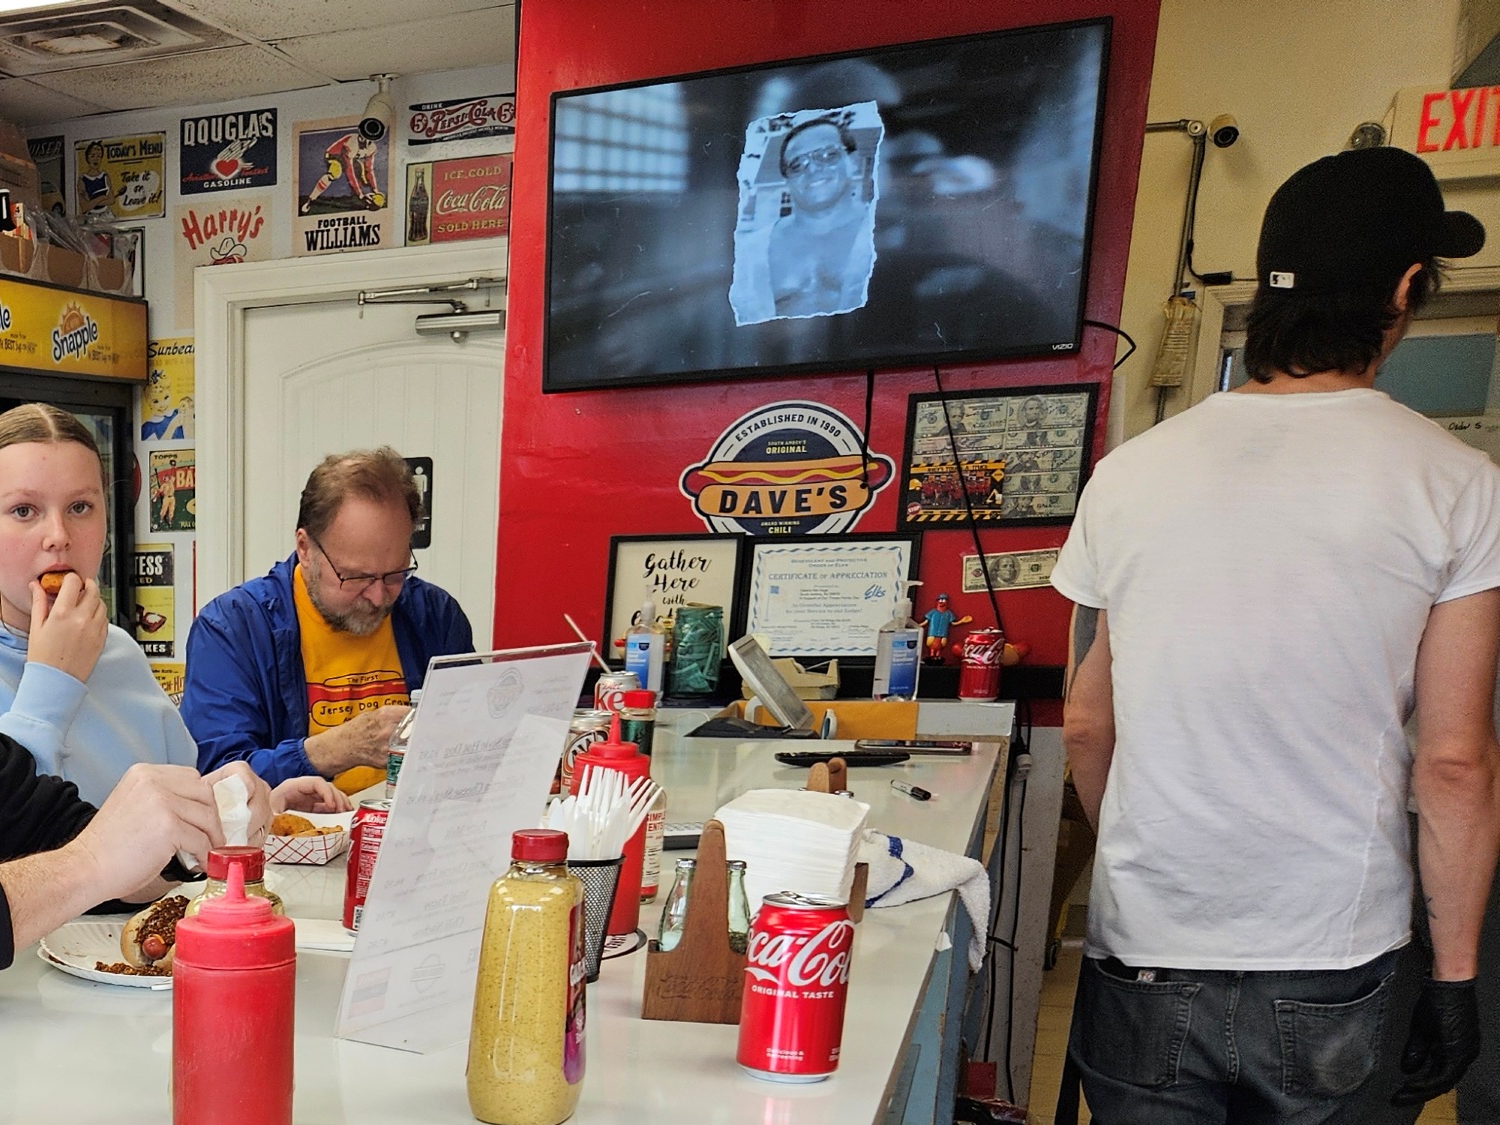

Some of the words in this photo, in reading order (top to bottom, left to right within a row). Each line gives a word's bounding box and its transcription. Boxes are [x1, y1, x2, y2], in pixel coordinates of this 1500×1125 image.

[422, 103, 443, 111] DRINK
[184, 112, 274, 146] DOUGLAS
[139, 142, 163, 156] MENU
[120, 170, 140, 183] Take
[141, 170, 150, 181] it
[444, 171, 463, 181] ICE
[469, 166, 502, 178] COLD
[204, 177, 252, 188] GASOLINE
[123, 195, 147, 207] Leave
[436, 185, 509, 215] Coca-Cola
[182, 205, 265, 250] Harry's
[318, 215, 368, 229] FOOTBALL
[437, 221, 469, 233] SOLD
[472, 219, 505, 230] HERE
[305, 224, 381, 252] WILLIAMS
[53, 316, 98, 362] Snapple
[734, 412, 805, 443] ESTABLISHED
[806, 414, 819, 426] IN
[819, 417, 842, 439] 1990
[153, 453, 178, 461] TOPPS
[765, 445, 808, 455] ORIGINAL
[719, 484, 849, 514] DAVE'S
[768, 525, 792, 534] CHILI
[643, 549, 712, 578] Gather
[768, 573, 818, 581] CERTIFICATE
[830, 571, 888, 579] APPRECIATION
[652, 573, 700, 594] Here
[864, 584, 887, 600] Elks
[347, 676, 359, 684] The
[360, 674, 379, 684] First
[320, 704, 354, 716] Jersey
[359, 702, 379, 711] Dog
[752, 984, 799, 999] ORIGINAL
[802, 991, 834, 999] TASTE
